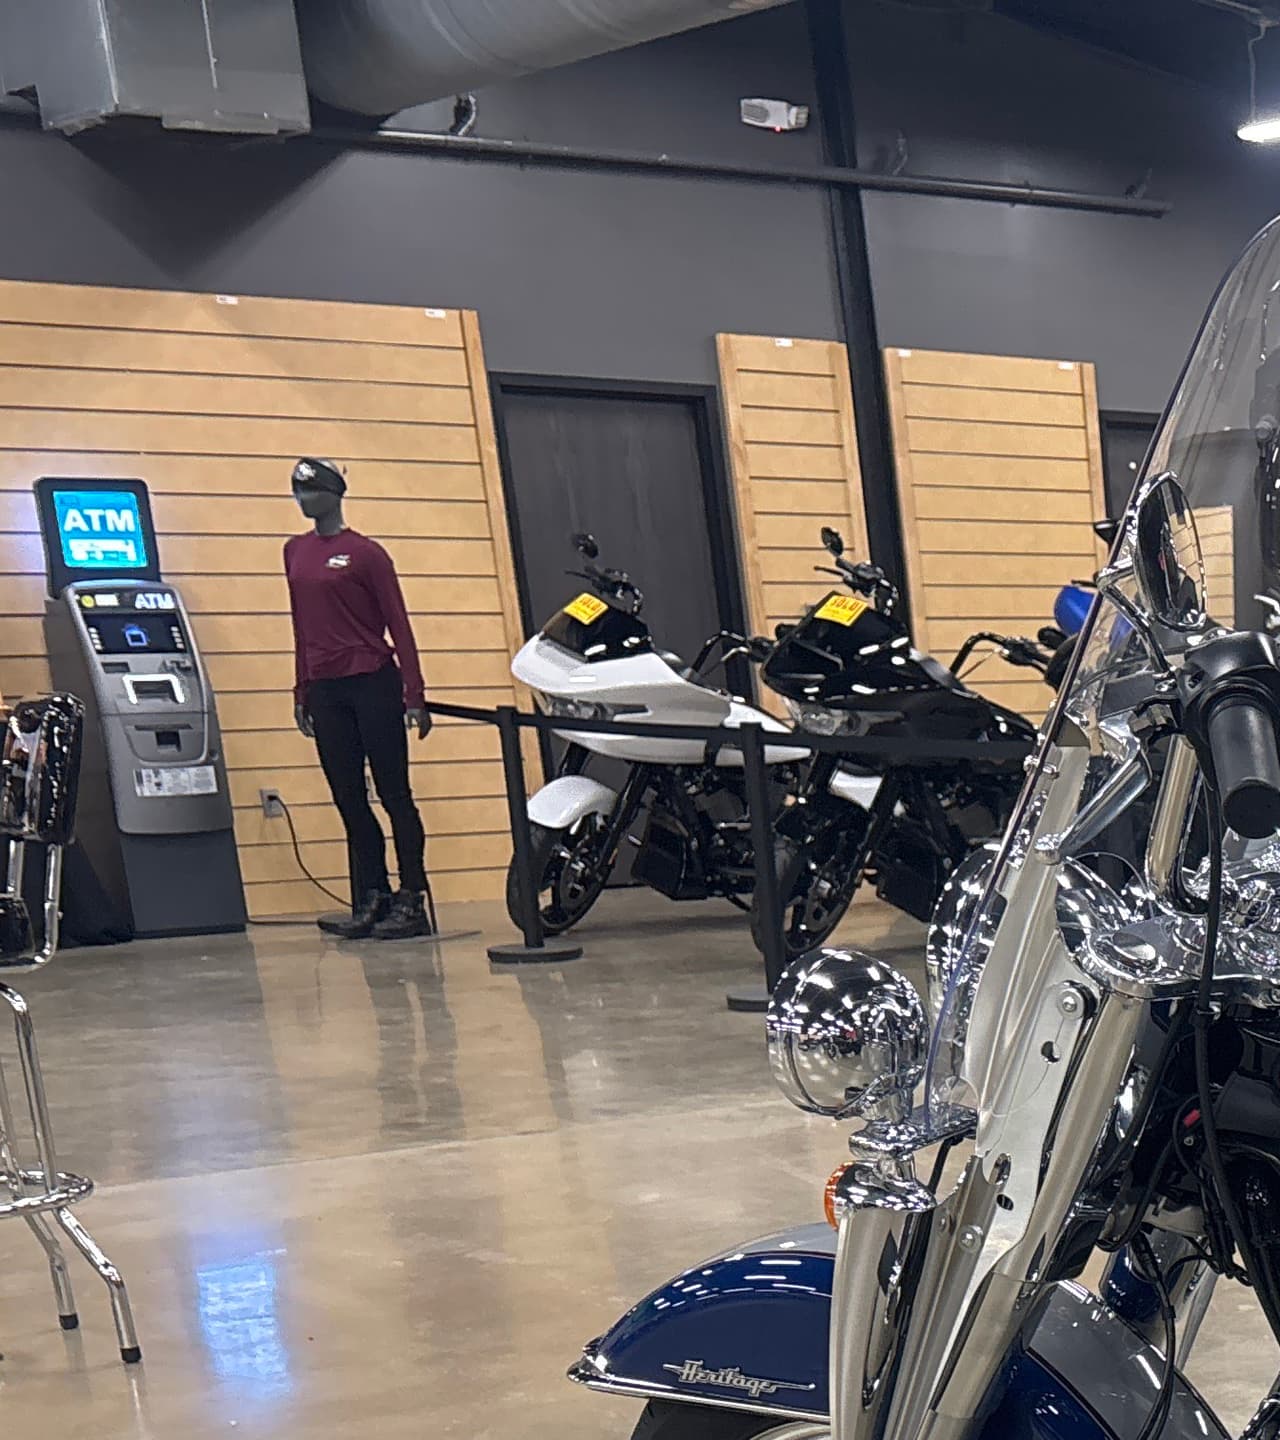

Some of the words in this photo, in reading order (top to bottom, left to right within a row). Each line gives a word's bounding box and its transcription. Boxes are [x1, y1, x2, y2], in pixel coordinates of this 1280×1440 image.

[63, 508, 136, 532] ATM
[135, 593, 176, 609] ATM
[678, 1359, 778, 1397] Heritage
